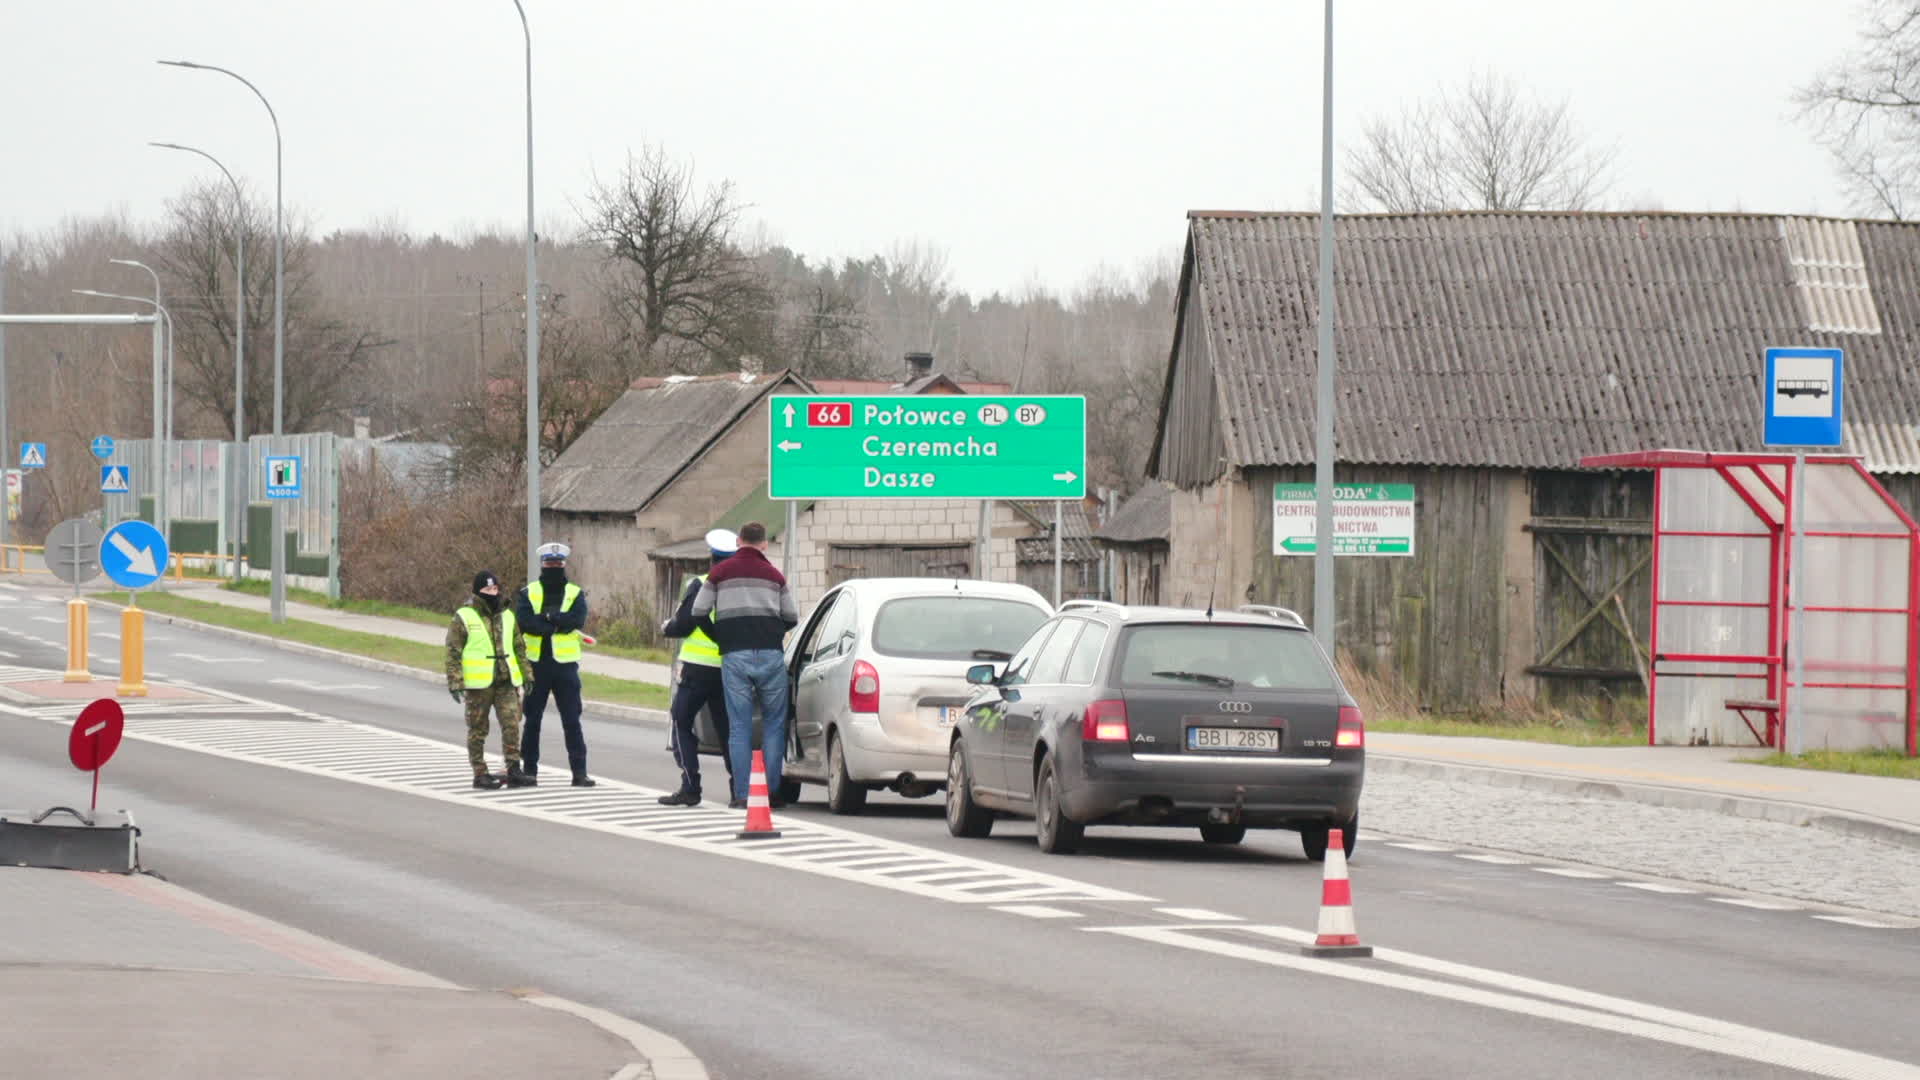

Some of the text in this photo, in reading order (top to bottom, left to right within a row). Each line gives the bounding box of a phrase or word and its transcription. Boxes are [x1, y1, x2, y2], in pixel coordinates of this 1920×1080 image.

[817, 404, 1039, 426] 66 Połowce PL BY
[862, 435, 999, 457] Czeremcha
[864, 466, 936, 488] Dasze
[1281, 487, 1373, 500] FIRMA "ODA"
[1276, 504, 1318, 518] CENTRU
[1198, 730, 1276, 748] BBI 28SY
